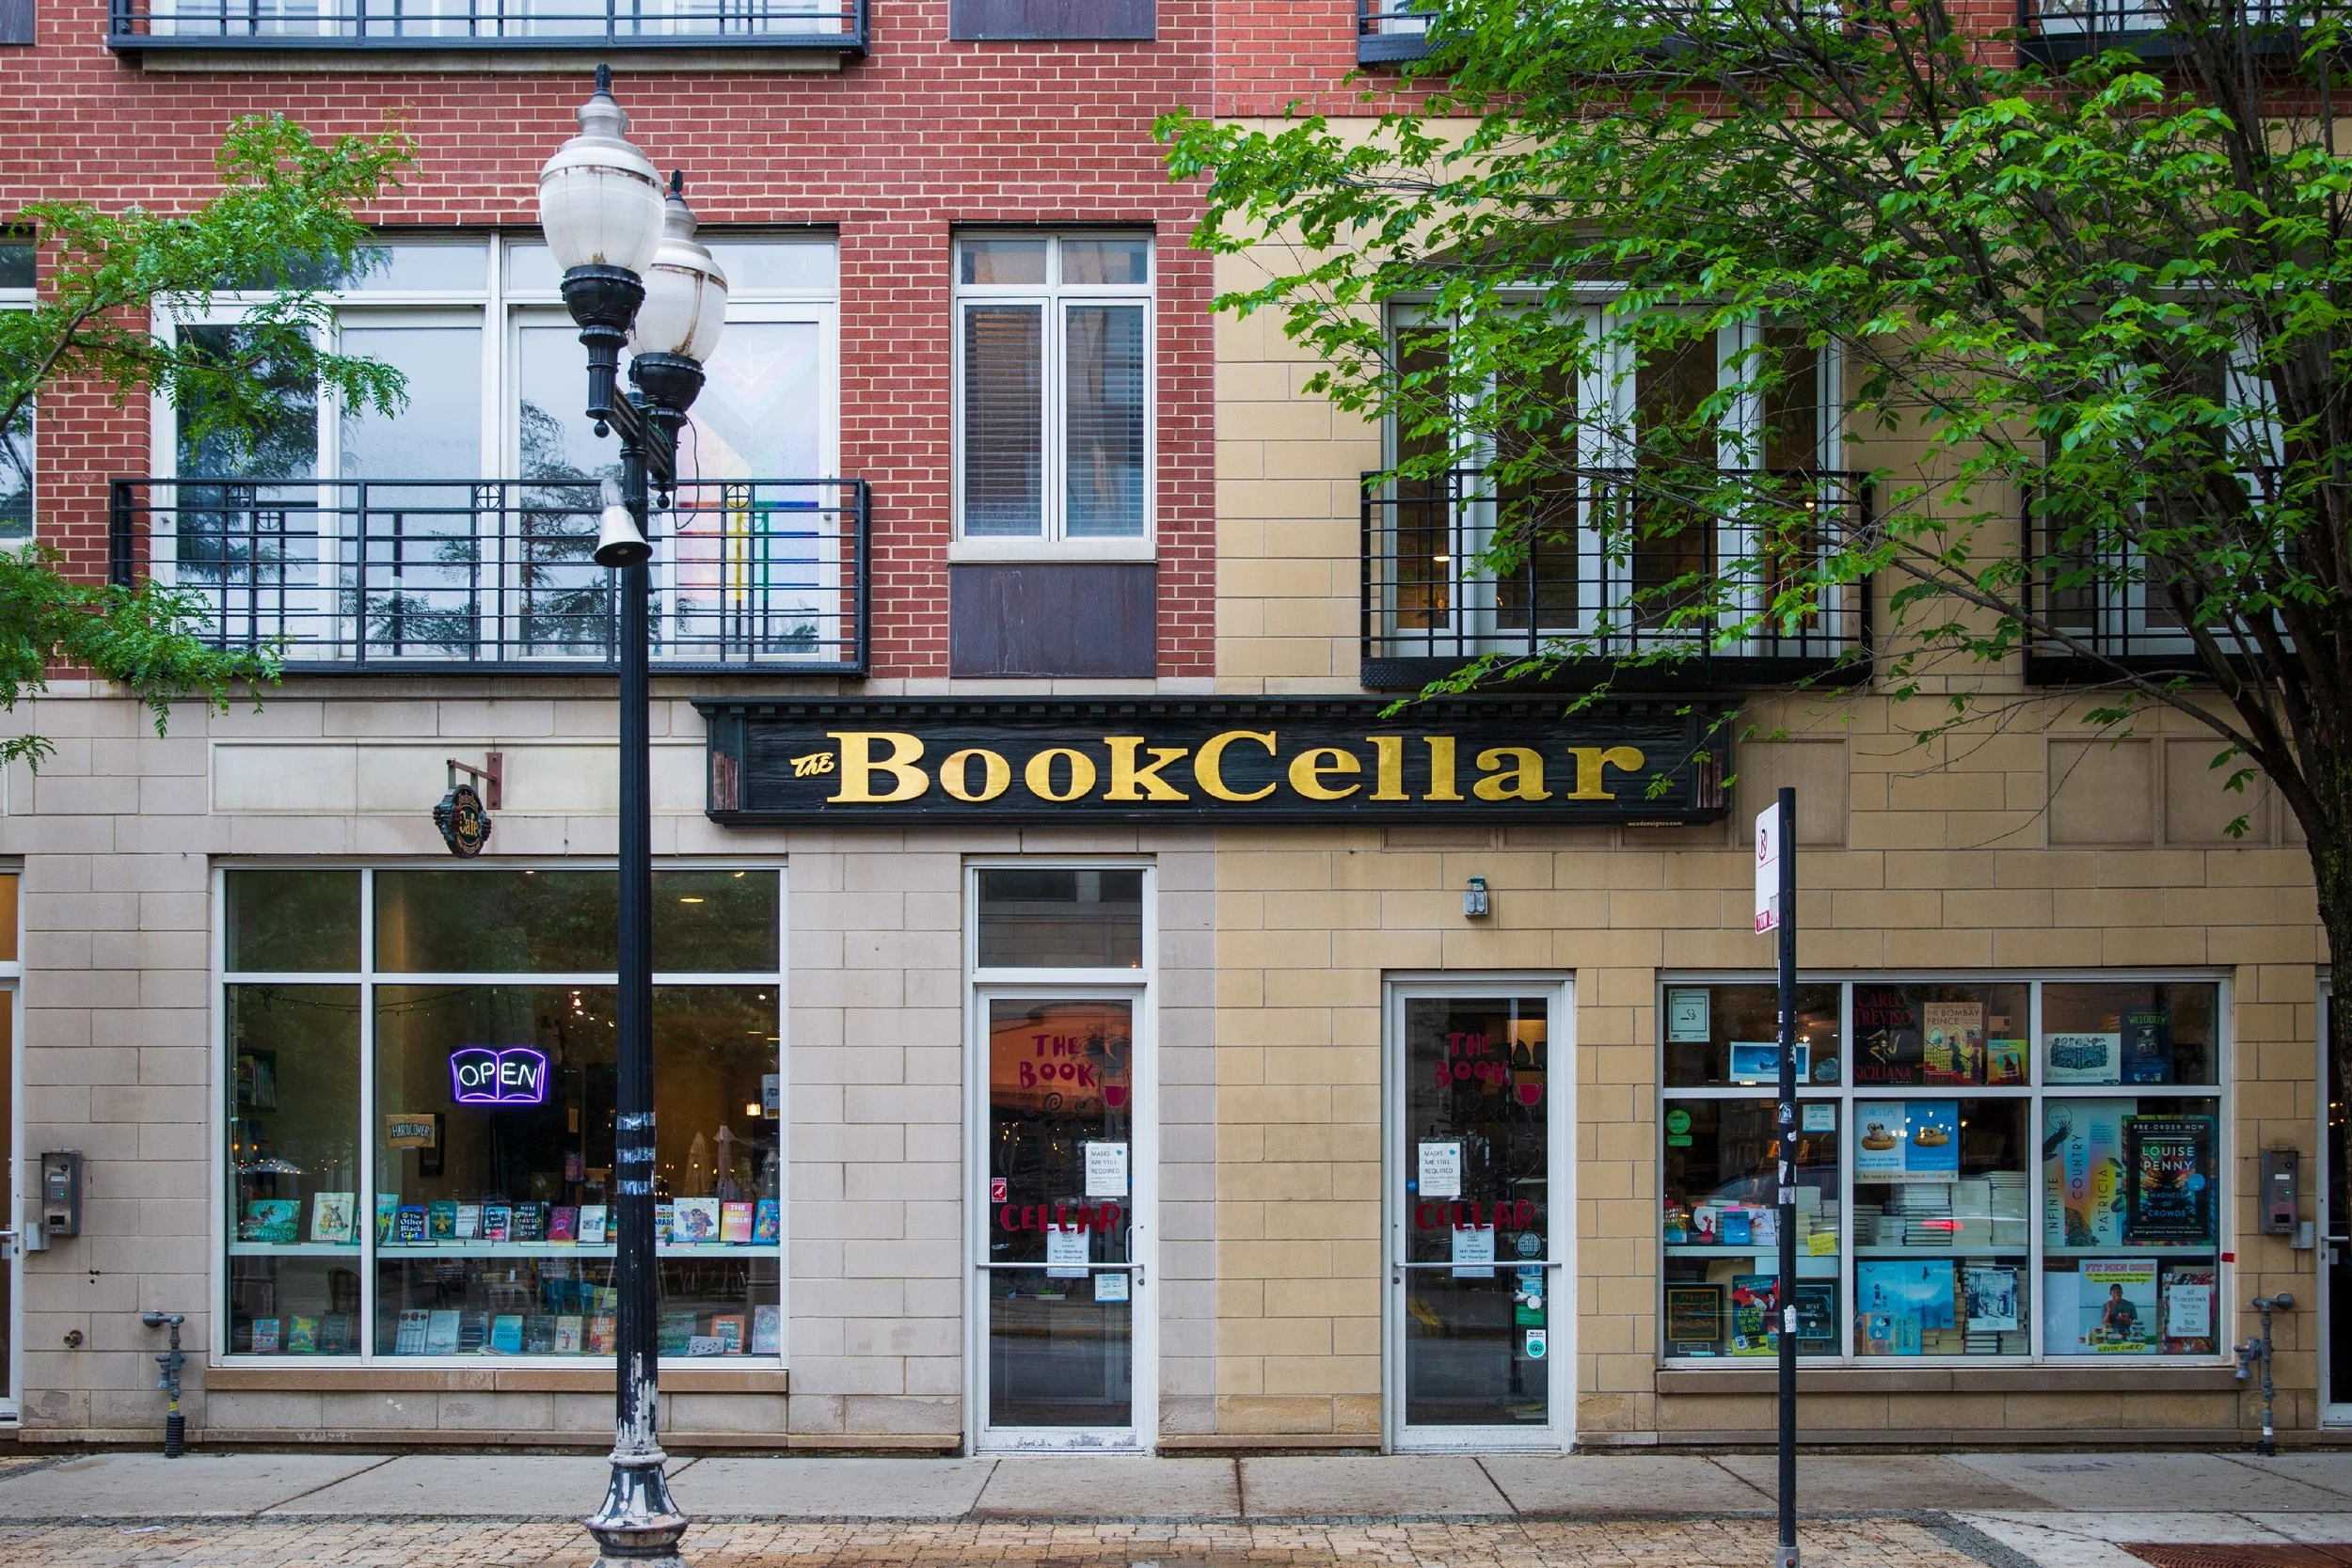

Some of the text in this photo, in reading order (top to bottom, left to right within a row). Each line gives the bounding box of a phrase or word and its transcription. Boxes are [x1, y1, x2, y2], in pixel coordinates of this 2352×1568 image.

[1756, 911, 1769, 931] TOW
[1856, 988, 1908, 1008] CARLO
[1853, 1007, 1913, 1026] TREVISO
[1927, 1017, 1960, 1025] PRINCE
[1941, 1008, 1980, 1017] BOMBAY
[1031, 1034, 1080, 1057] THE
[1445, 1032, 1493, 1058] THE
[458, 1062, 537, 1088] OPEN
[1020, 1061, 1096, 1090] BOOK
[1433, 1060, 1511, 1092] BOOK
[2141, 1147, 2195, 1157] LOUISE
[2072, 1133, 2083, 1200] COUNTRY
[2143, 1161, 2193, 1171] PENNY
[2047, 1178, 2058, 1234] INFINITE
[2098, 1169, 2108, 1232] PATRICIA
[999, 1201, 1121, 1234] CELLAR
[1415, 1198, 1536, 1232] CELLAR
